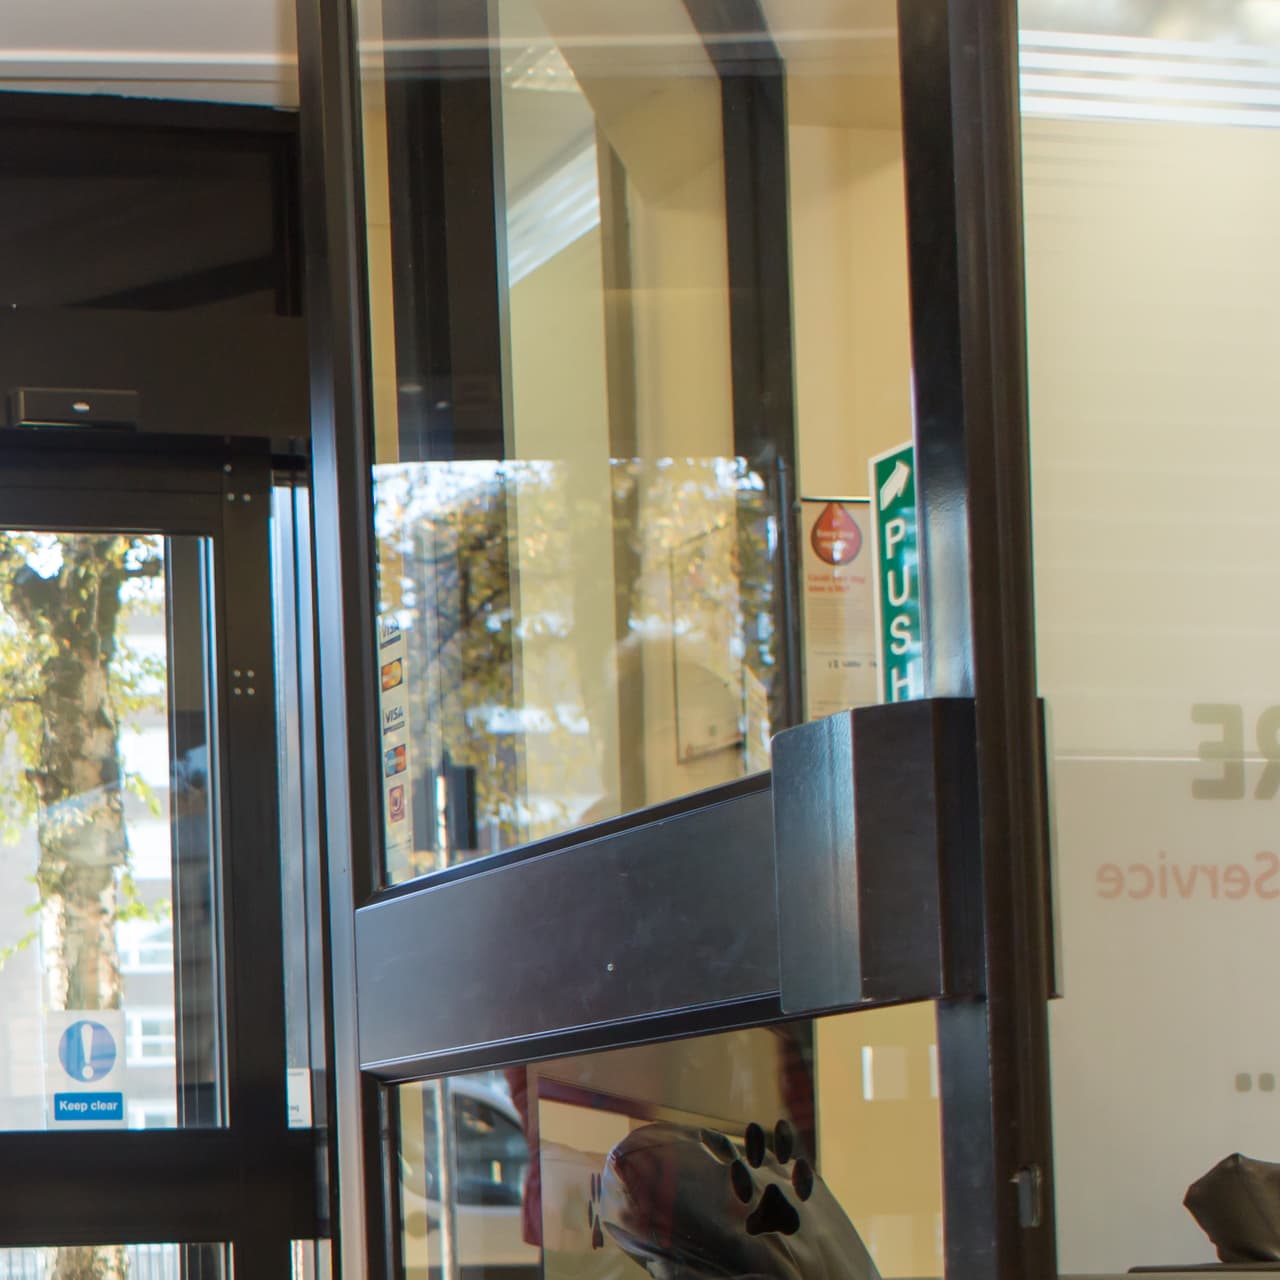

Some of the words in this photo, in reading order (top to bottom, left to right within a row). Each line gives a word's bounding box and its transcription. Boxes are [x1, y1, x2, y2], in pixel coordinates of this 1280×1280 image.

[885, 517, 914, 703] PUSH
[385, 706, 403, 723] VISA
[59, 1100, 88, 1112] Keep
[91, 1100, 118, 1111] clear
